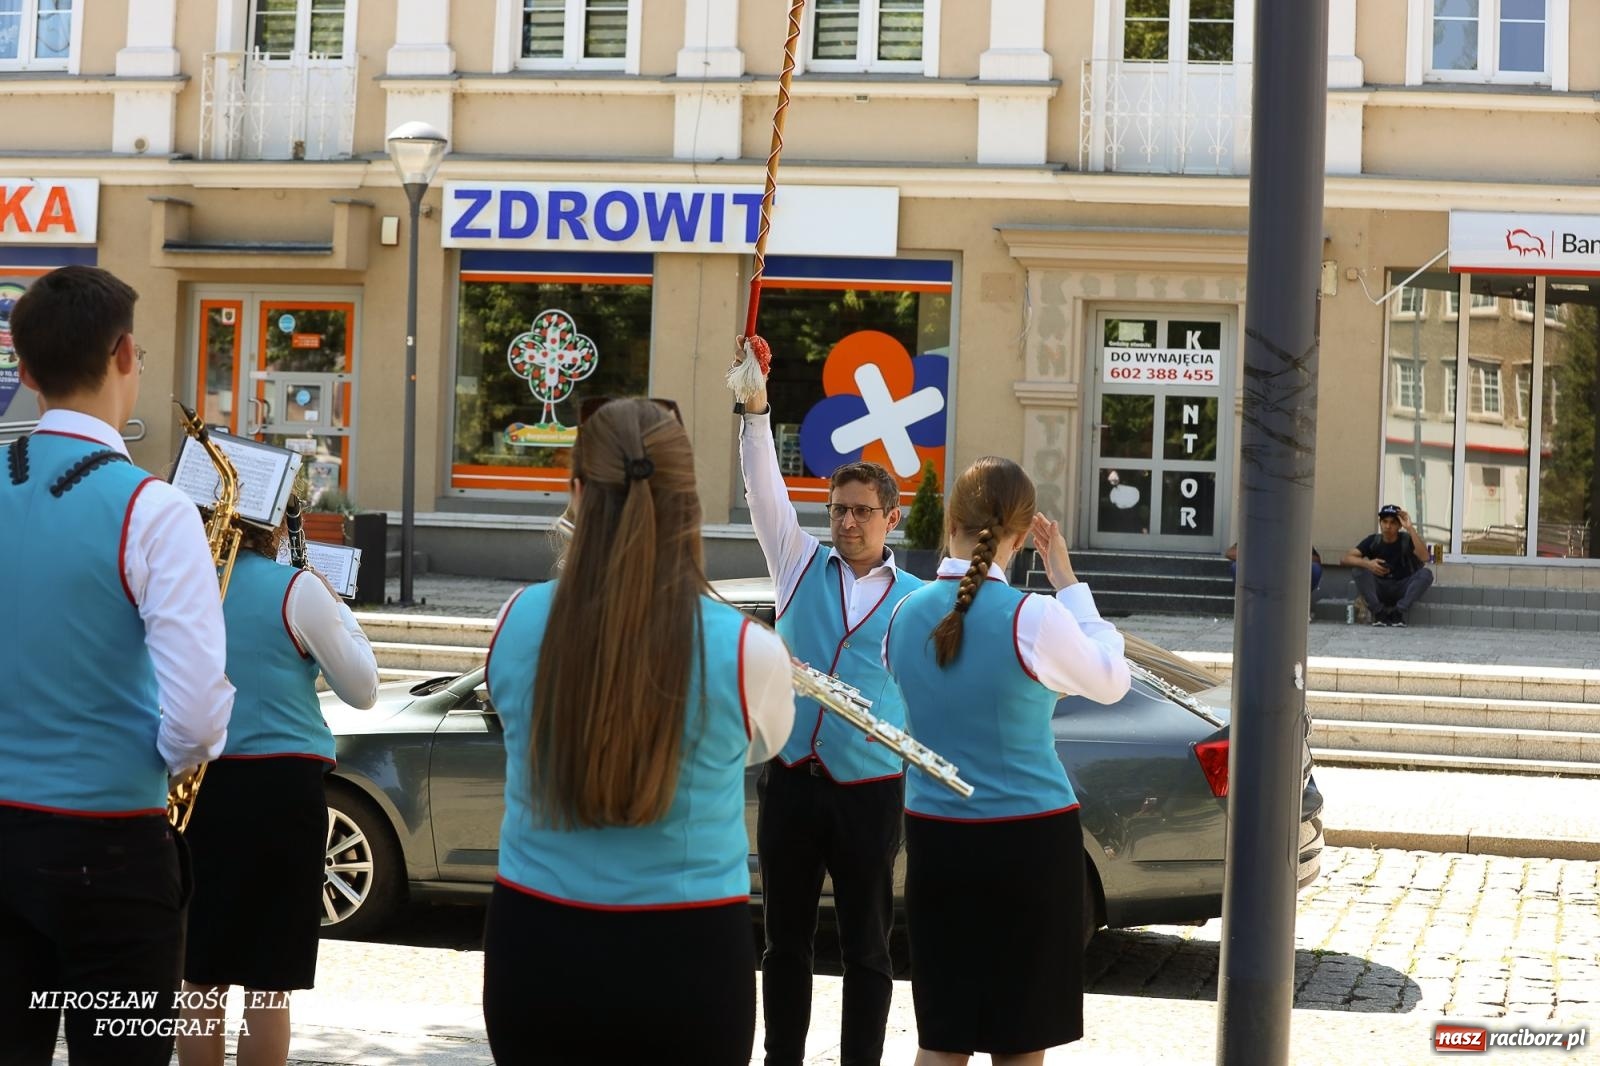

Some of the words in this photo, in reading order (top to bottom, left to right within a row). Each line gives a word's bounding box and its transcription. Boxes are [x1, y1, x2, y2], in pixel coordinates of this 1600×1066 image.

[0, 185, 77, 233] KA
[449, 188, 776, 243] ZDROWIT
[1110, 351, 1132, 363] DO
[1135, 352, 1215, 367] WYNAJĘCIA
[1110, 368, 1141, 380] 602
[1146, 368, 1178, 380] 388
[1183, 369, 1214, 382] 455
